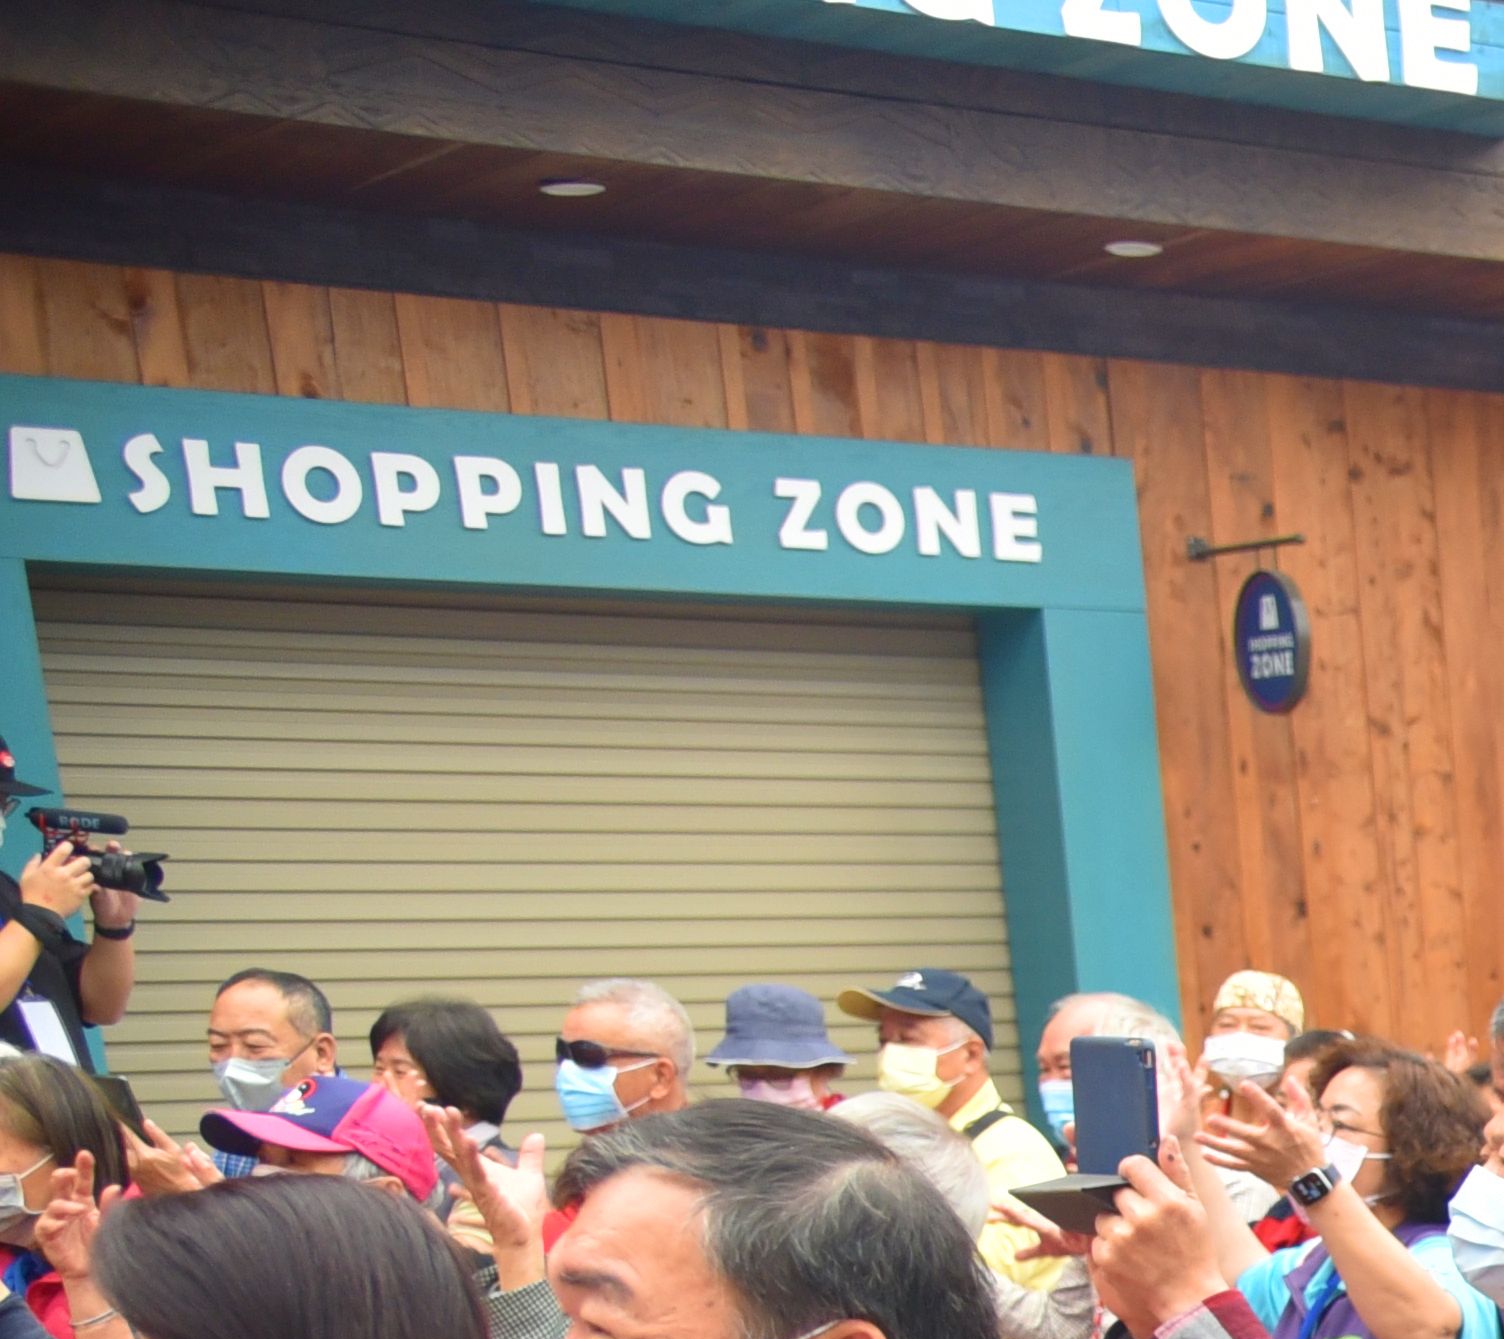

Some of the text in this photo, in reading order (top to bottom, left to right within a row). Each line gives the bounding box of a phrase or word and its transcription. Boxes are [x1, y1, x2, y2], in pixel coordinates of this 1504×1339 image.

[123, 433, 1043, 564] SHOPPING ZONE
[1249, 649, 1295, 680] ZONE
